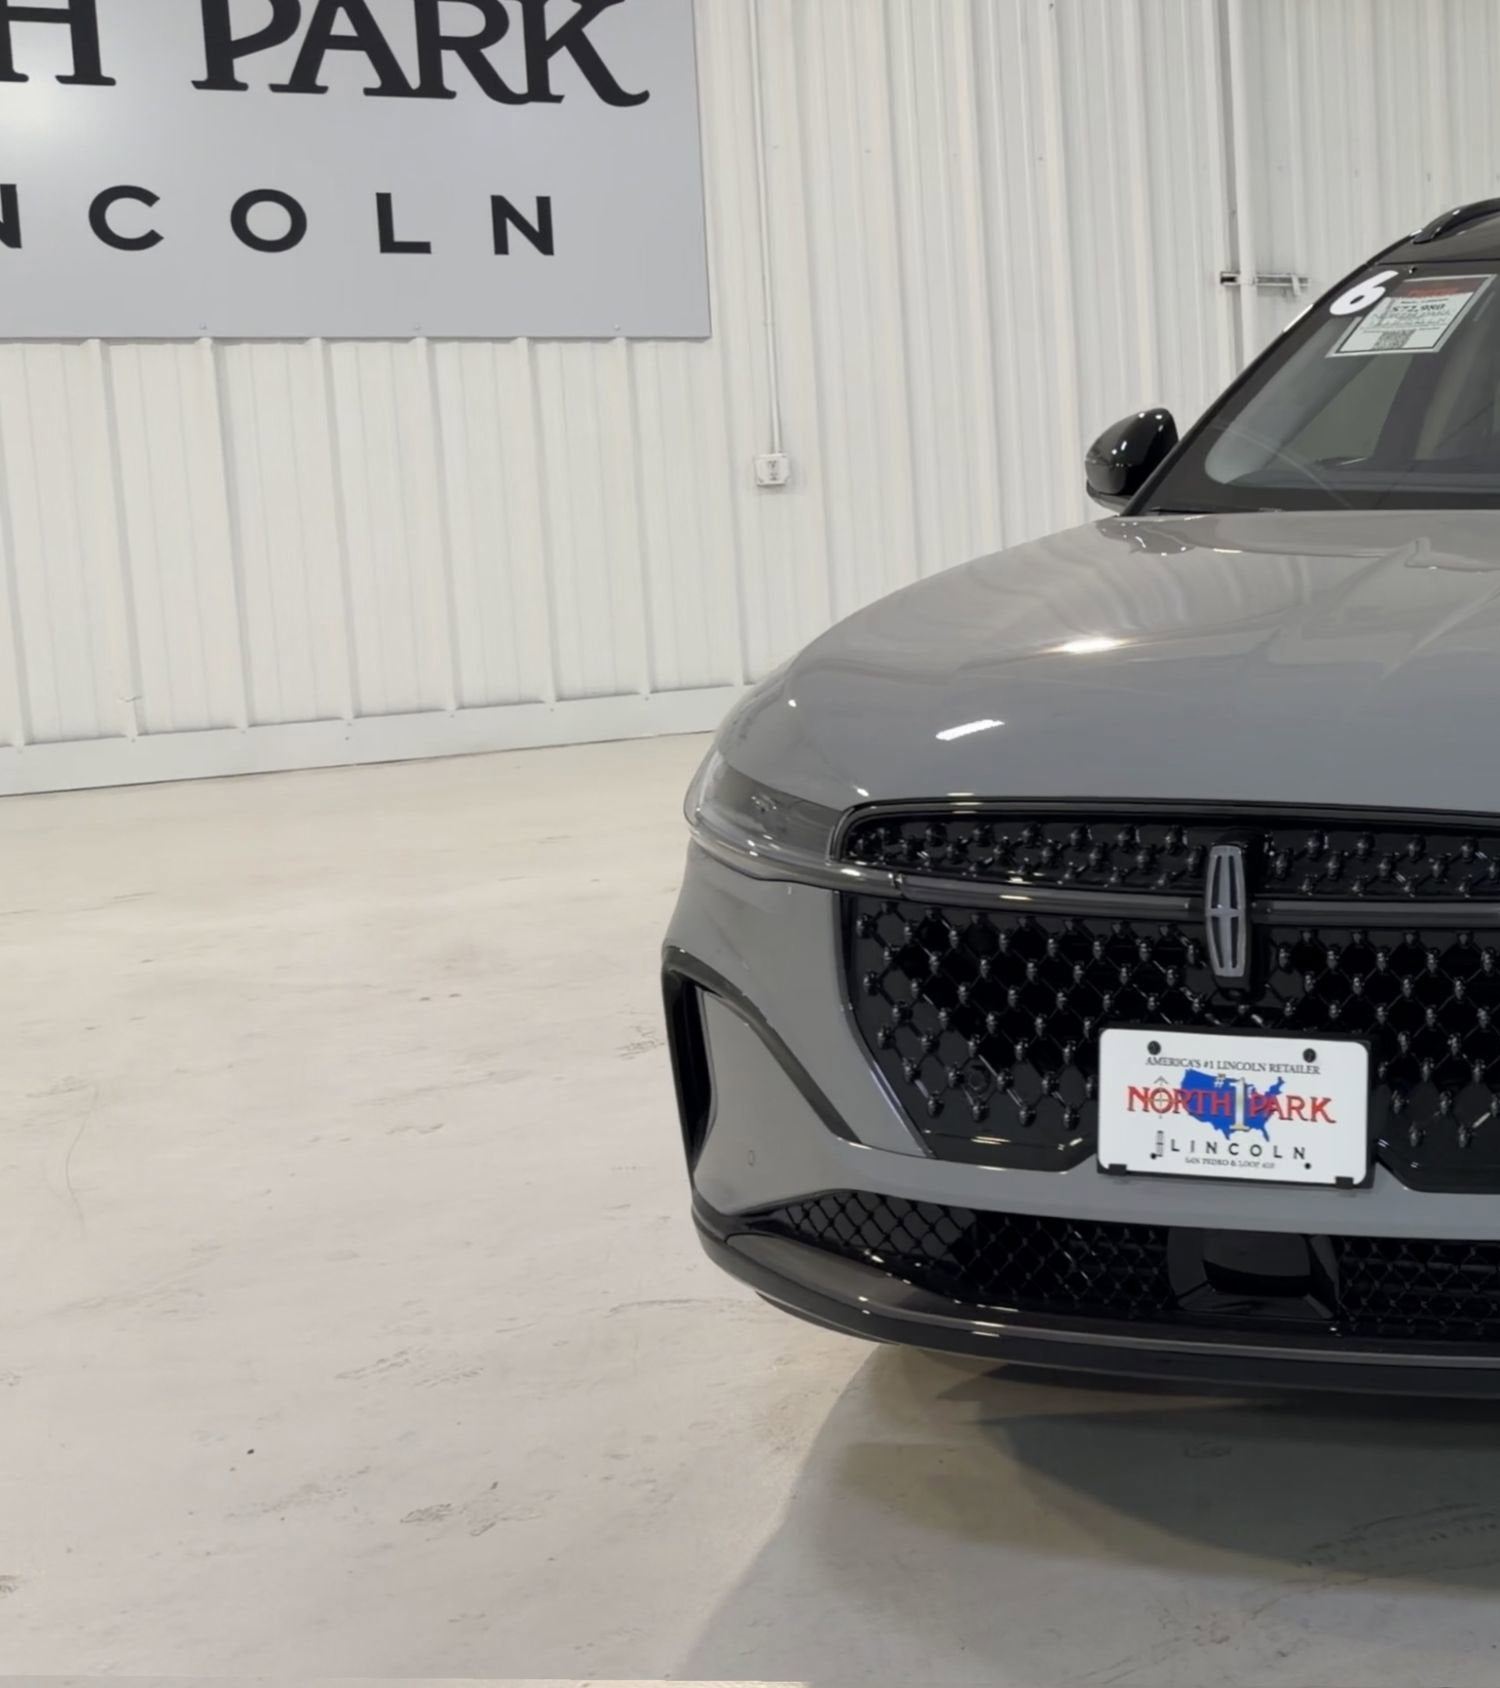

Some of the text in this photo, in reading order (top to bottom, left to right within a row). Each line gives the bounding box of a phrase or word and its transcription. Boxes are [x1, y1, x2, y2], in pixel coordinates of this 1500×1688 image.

[191, 0, 650, 107] PARK
[1329, 270, 1399, 316] 6
[1145, 1056, 1321, 1075] AMERICA'S #1 LINCOLN RETAILER
[1127, 1085, 1337, 1124] NORTH PARK
[1170, 1138, 1306, 1160] LINCOLN
